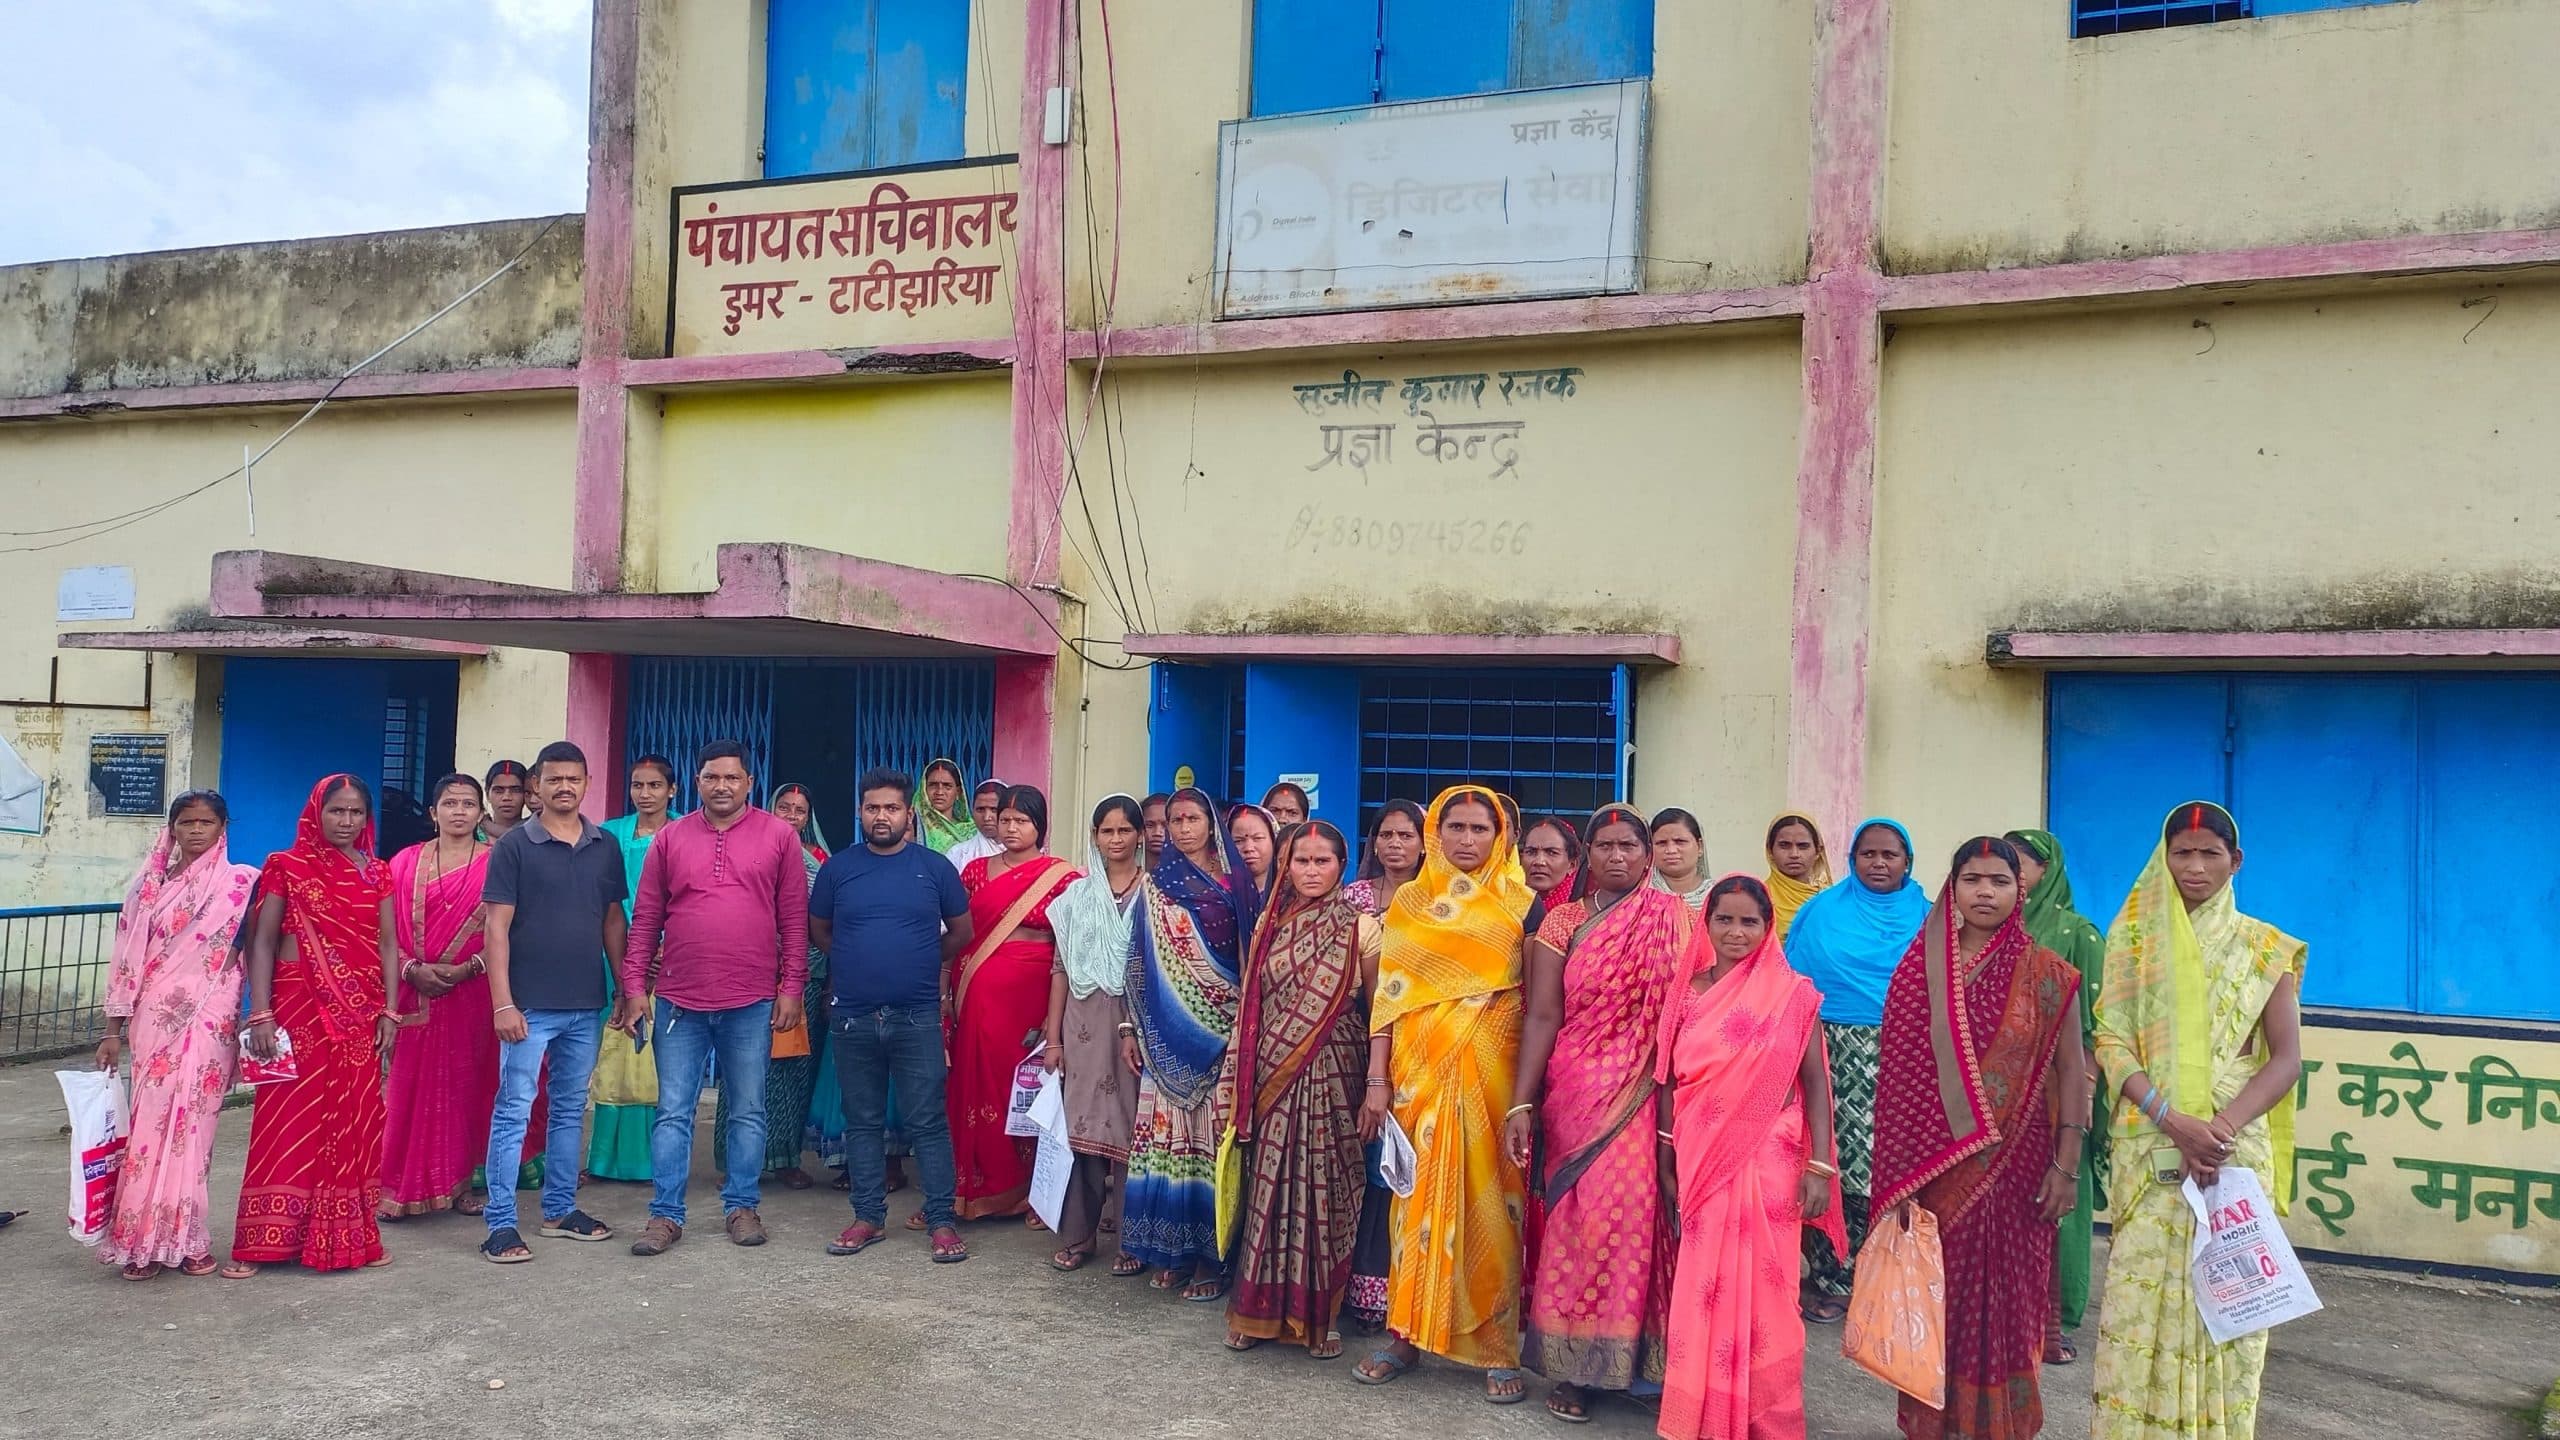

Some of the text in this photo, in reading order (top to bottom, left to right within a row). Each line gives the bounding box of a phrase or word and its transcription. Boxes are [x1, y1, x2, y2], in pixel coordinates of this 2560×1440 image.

[1511, 109, 1616, 145] प्रज्ञा केंद्र
[684, 202, 834, 267] पंचायत
[2336, 1041, 2448, 1130] करे
[2221, 1221, 2260, 1242] MOBILE
